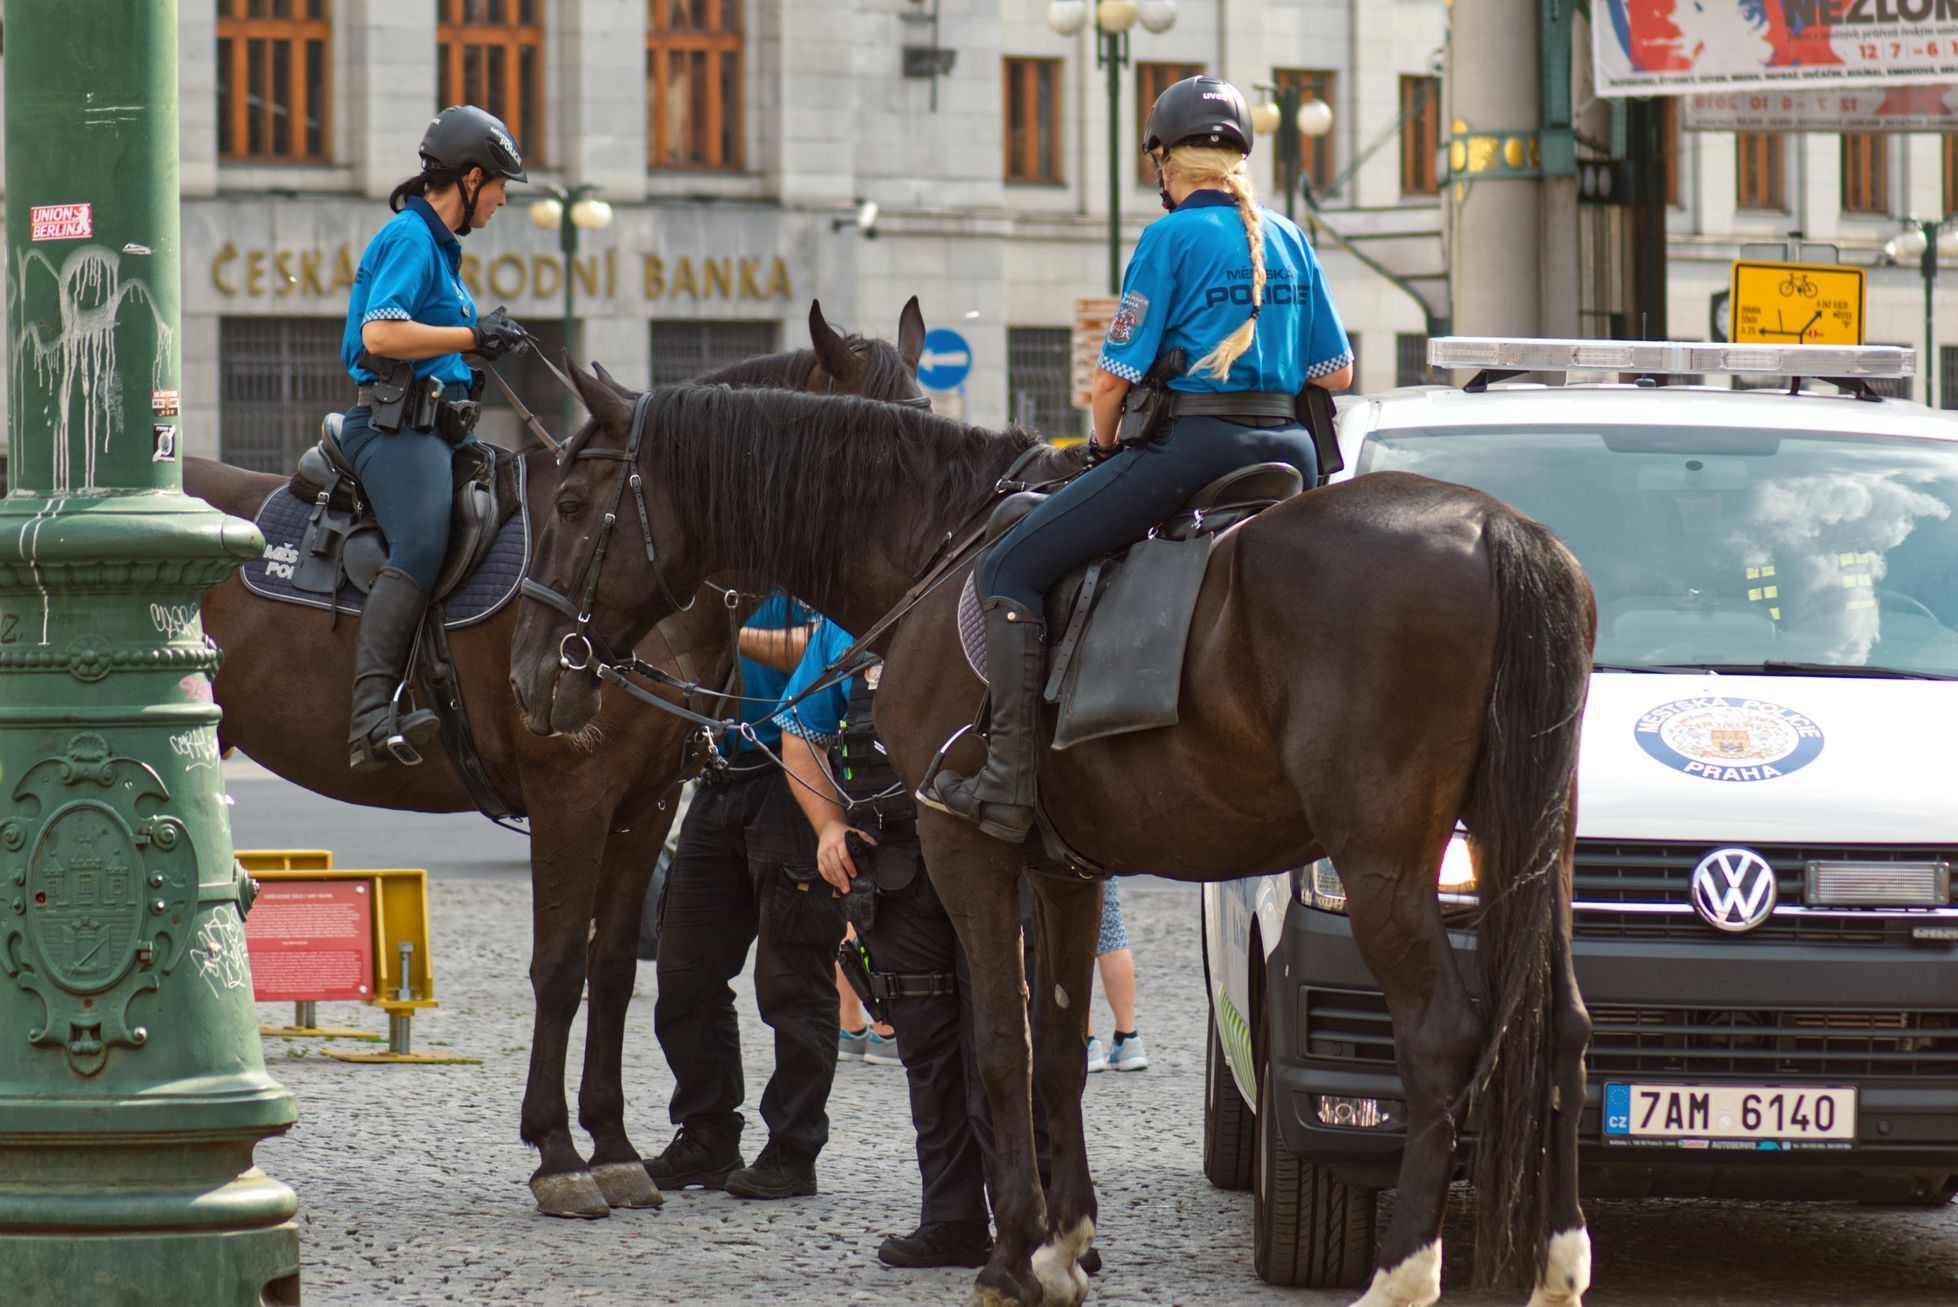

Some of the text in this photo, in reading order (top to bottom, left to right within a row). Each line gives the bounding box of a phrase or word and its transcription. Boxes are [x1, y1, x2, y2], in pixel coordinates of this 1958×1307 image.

[1859, 44, 1878, 60] 12
[1891, 43, 1901, 58] 7
[1927, 42, 1939, 57] 6
[33, 207, 74, 222] UNION
[32, 223, 77, 238] BERLIN
[211, 240, 355, 297] ČESKÁ
[461, 244, 619, 300] RODNÍ
[643, 254, 793, 300] BANKA
[1226, 265, 1296, 281] MĚSKÁ
[1205, 283, 1311, 309] POICIE
[1741, 699, 1821, 738] POLICIE
[1683, 761, 1783, 781] PRAHA
[1640, 1091, 1835, 1132] 7AM 6140
[1609, 1115, 1627, 1128] CZ
